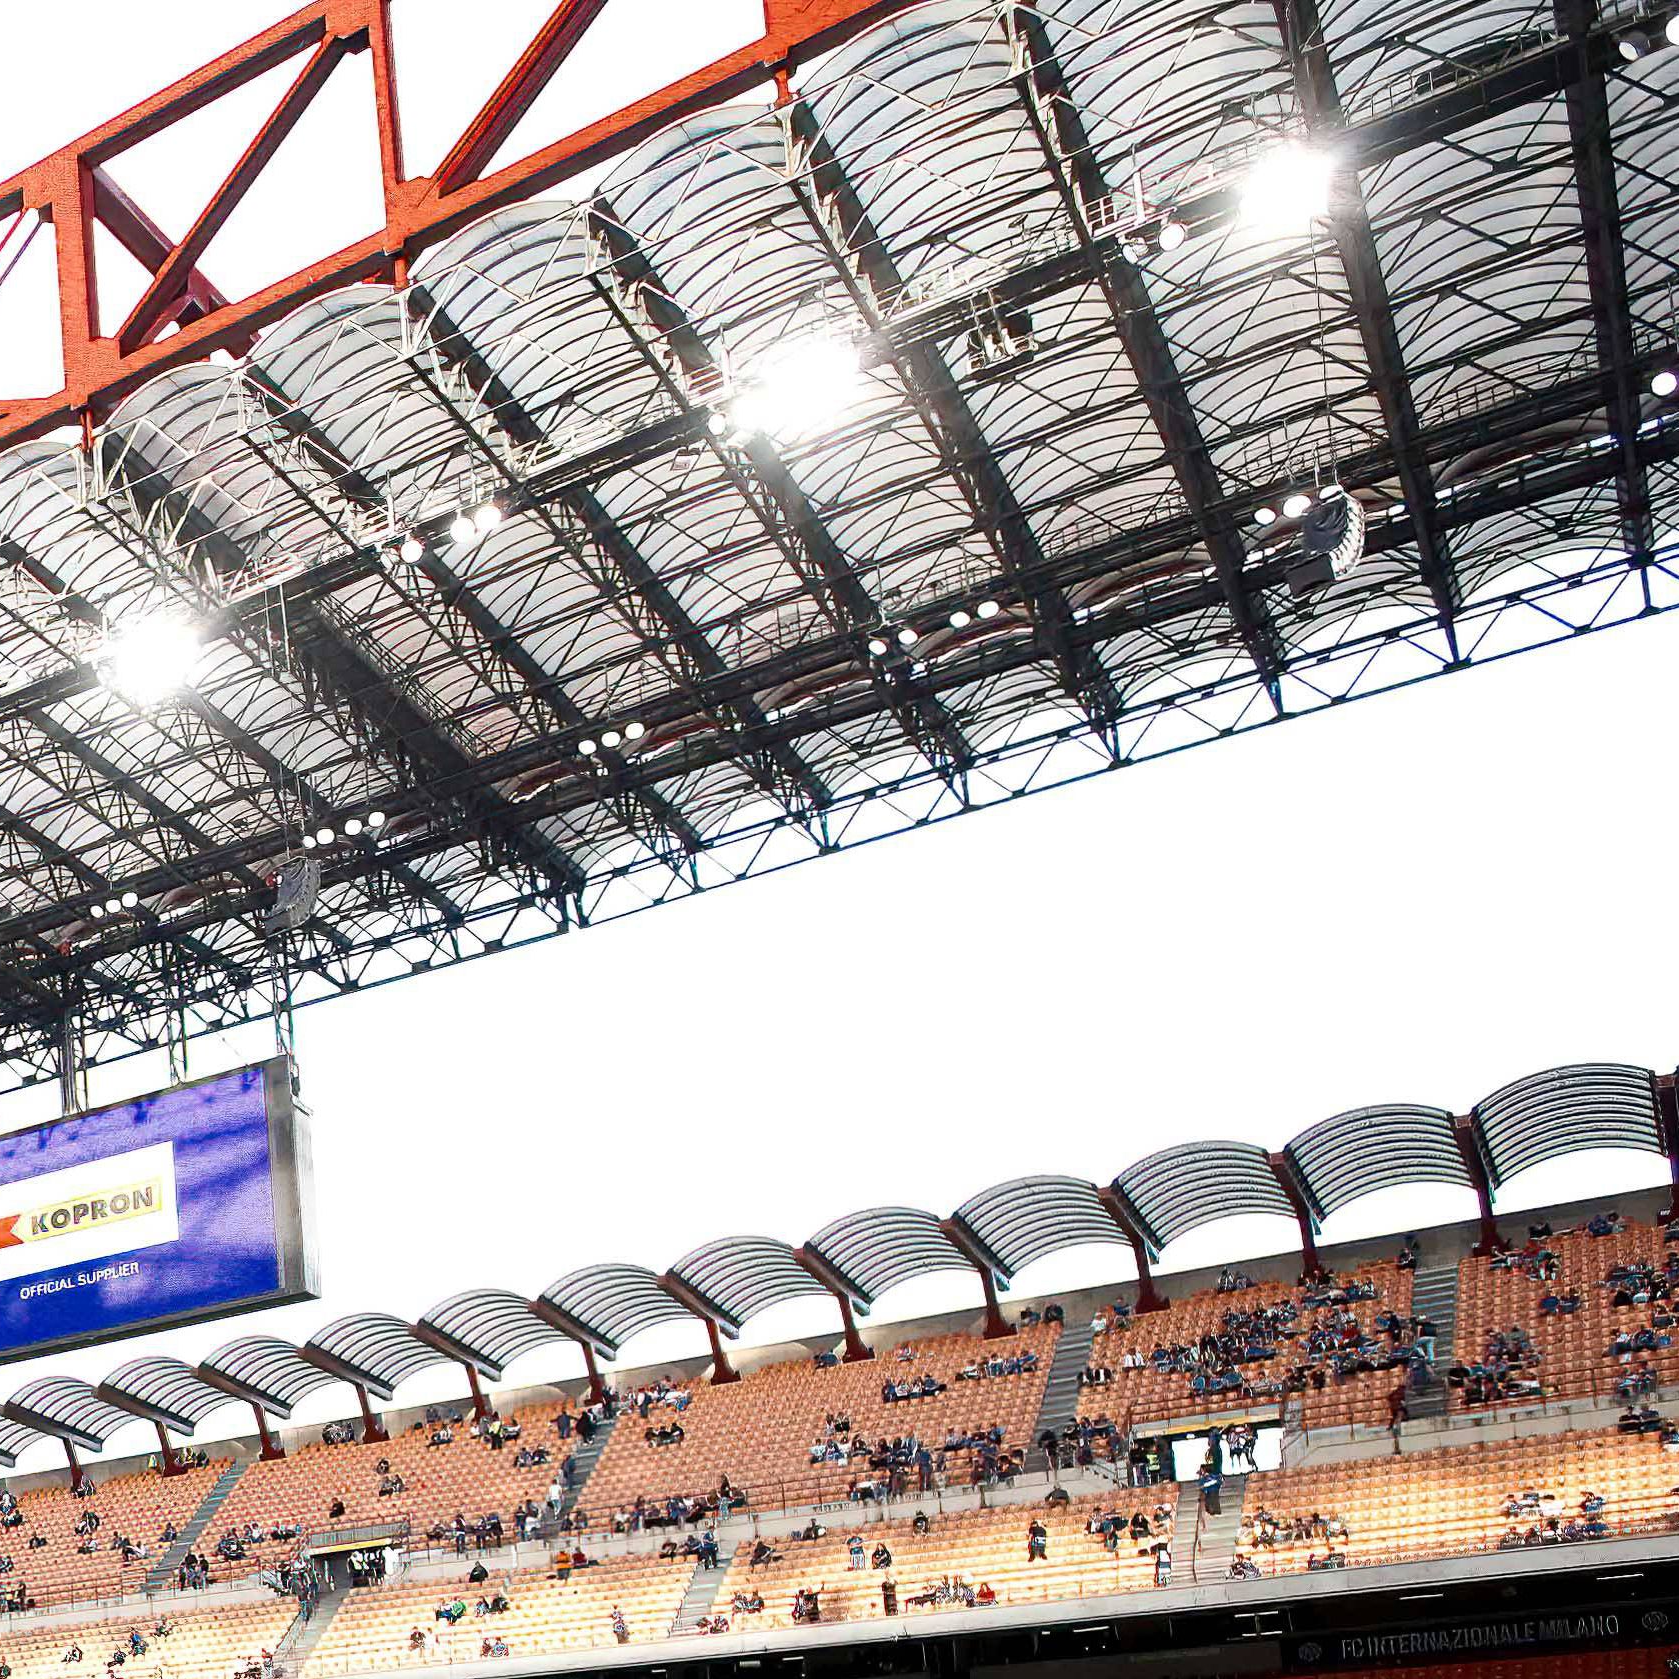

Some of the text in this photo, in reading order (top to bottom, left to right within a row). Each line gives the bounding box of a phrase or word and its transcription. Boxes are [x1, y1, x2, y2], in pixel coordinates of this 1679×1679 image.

[31, 1186, 153, 1235] KOPRON
[19, 1262, 140, 1300] OFFICIAL SUPPLIER
[1367, 1621, 1536, 1656] INTERNAZIONALE
[1538, 1615, 1619, 1640] MILANO
